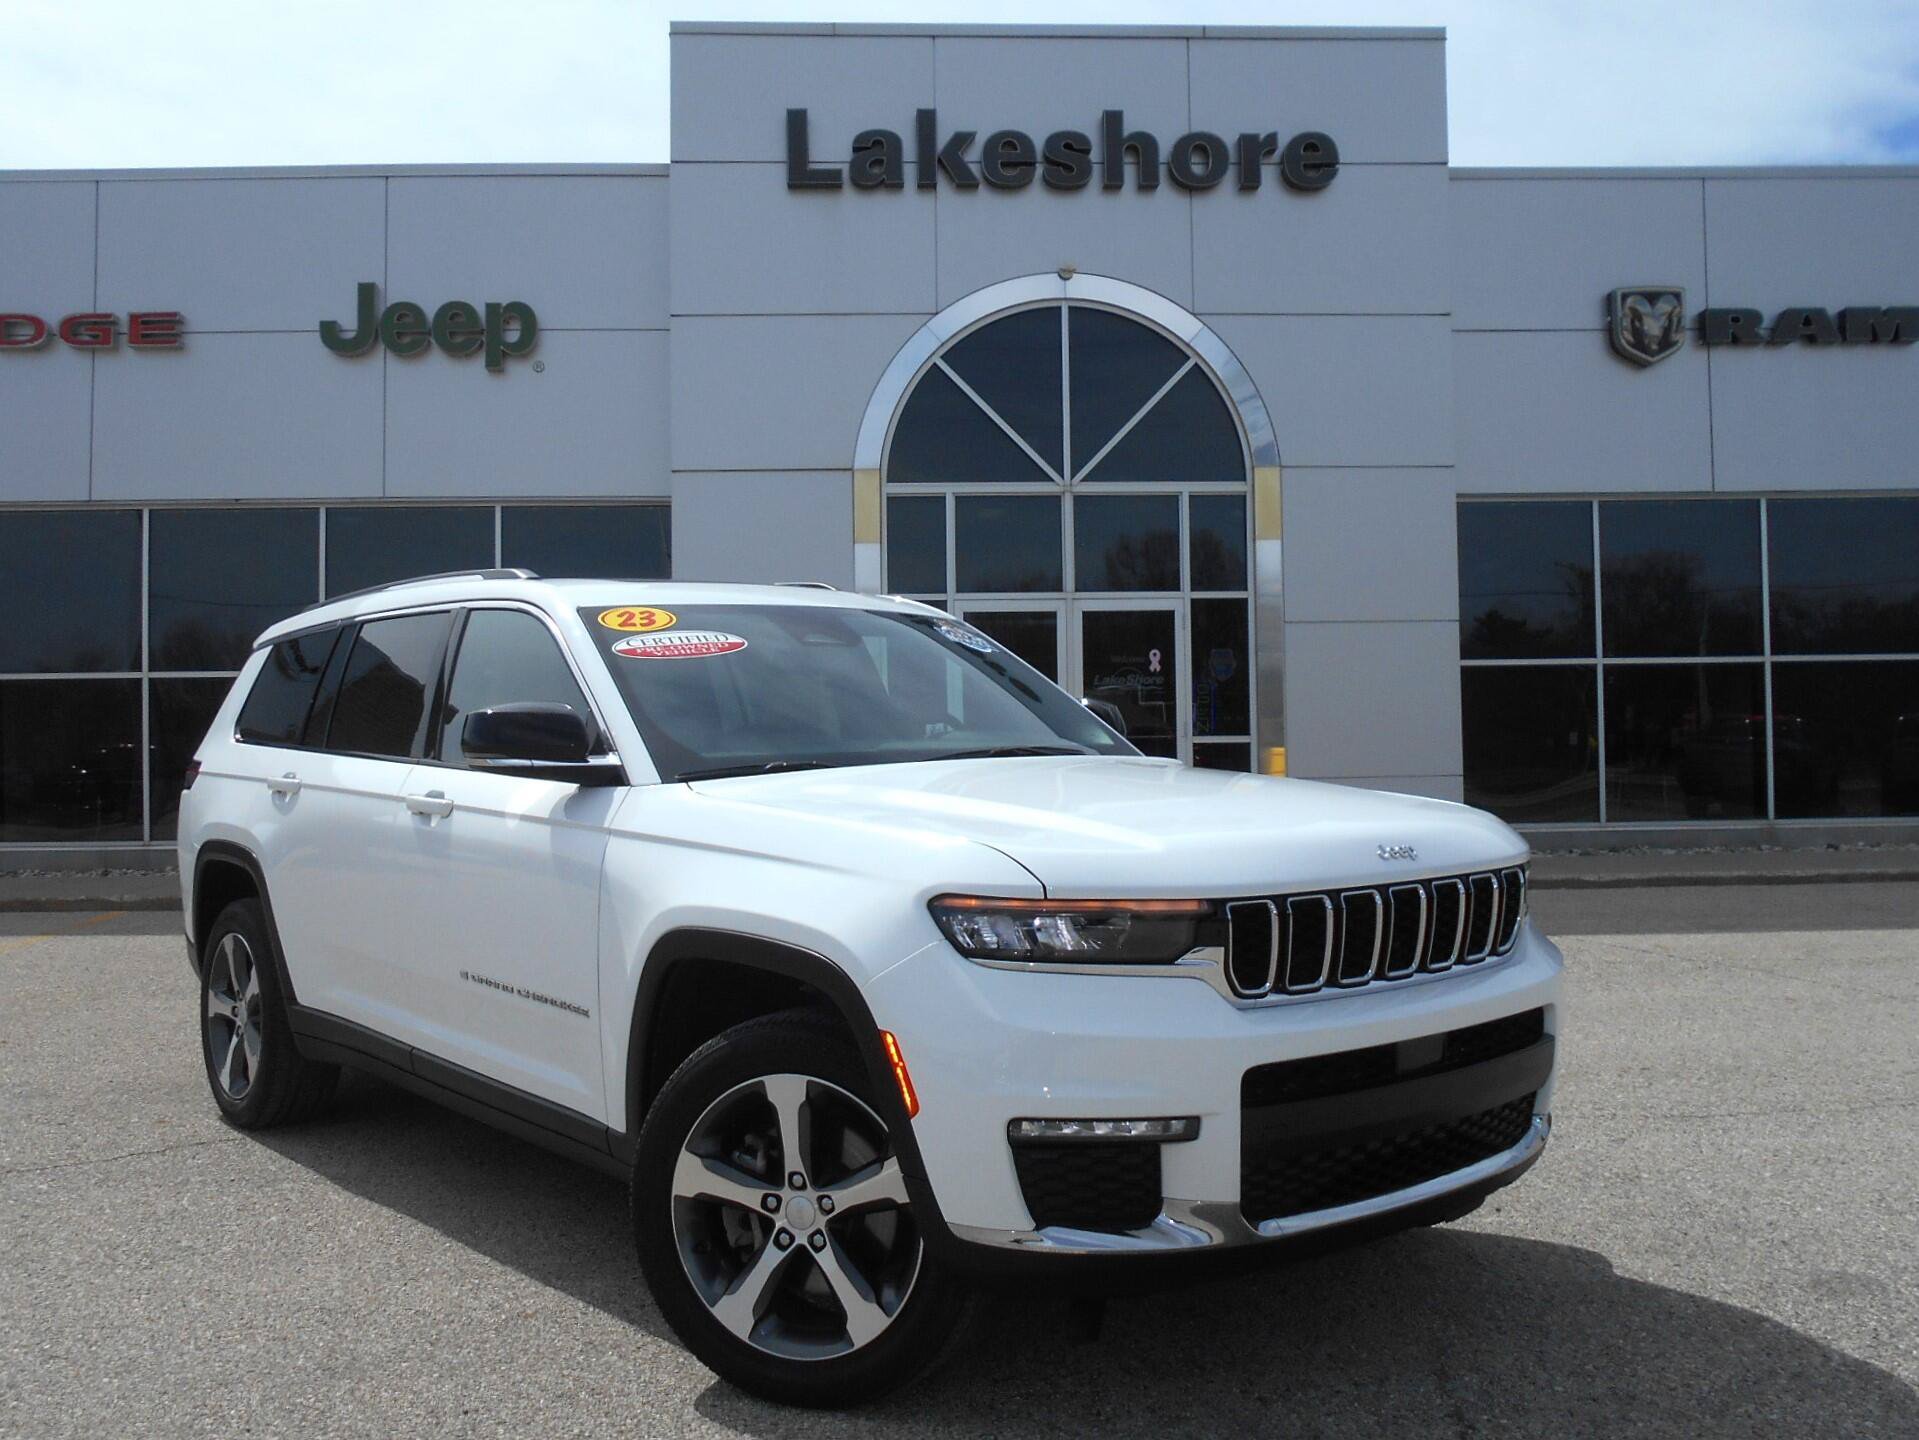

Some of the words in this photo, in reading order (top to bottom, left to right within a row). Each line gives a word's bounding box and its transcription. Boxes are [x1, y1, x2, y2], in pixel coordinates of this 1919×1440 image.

[786, 108, 1340, 191] Lakeshore
[319, 282, 538, 373] Jeep
[1696, 306, 1919, 346] RAM
[617, 610, 657, 627] 23
[626, 633, 729, 648] CERTIFIED
[1376, 844, 1418, 861] Jeep
